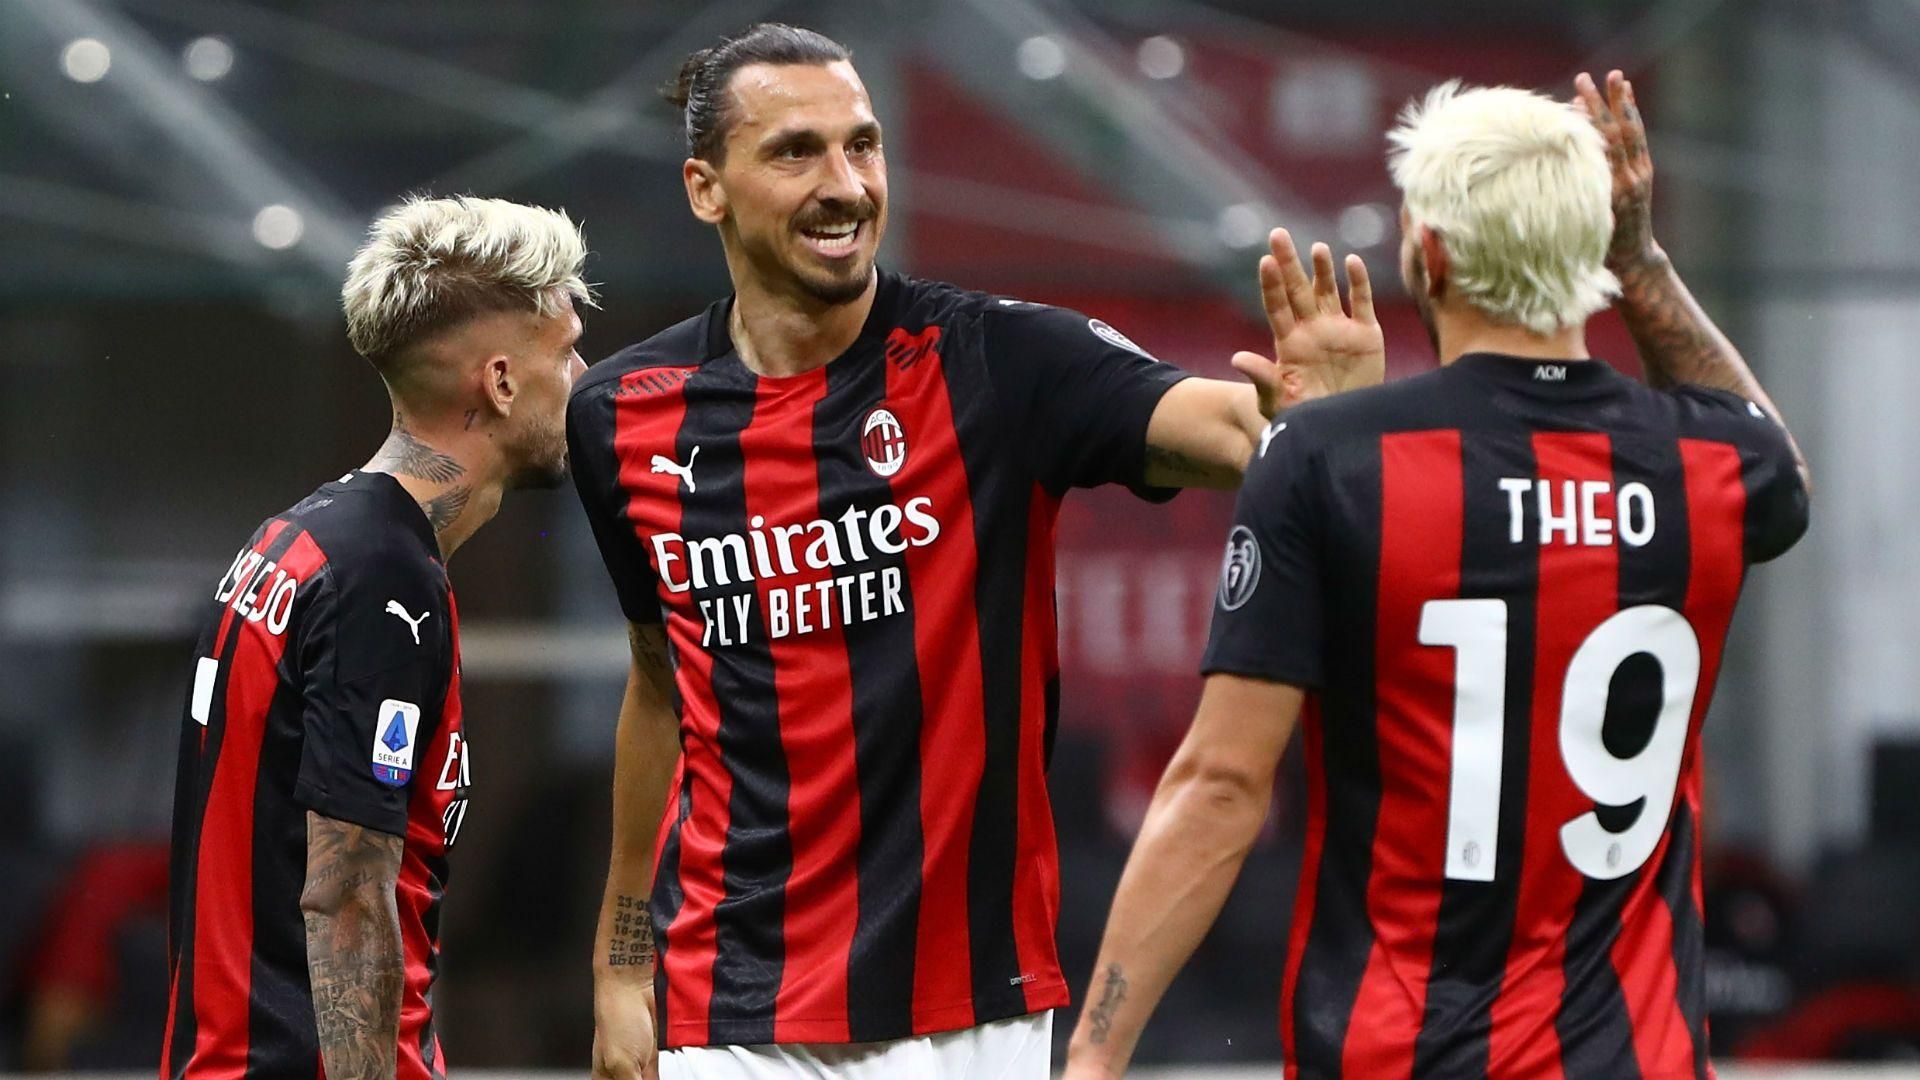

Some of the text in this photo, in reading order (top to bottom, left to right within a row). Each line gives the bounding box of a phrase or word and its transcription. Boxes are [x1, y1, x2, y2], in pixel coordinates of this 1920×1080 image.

[1534, 365, 1567, 380] ACM
[869, 411, 894, 426] ACM
[650, 496, 941, 593] Emirates
[1498, 478, 1656, 547] THEO
[699, 566, 906, 647] FLY BETTER
[378, 753, 400, 765] SERIE
[1418, 598, 1700, 881] 19
